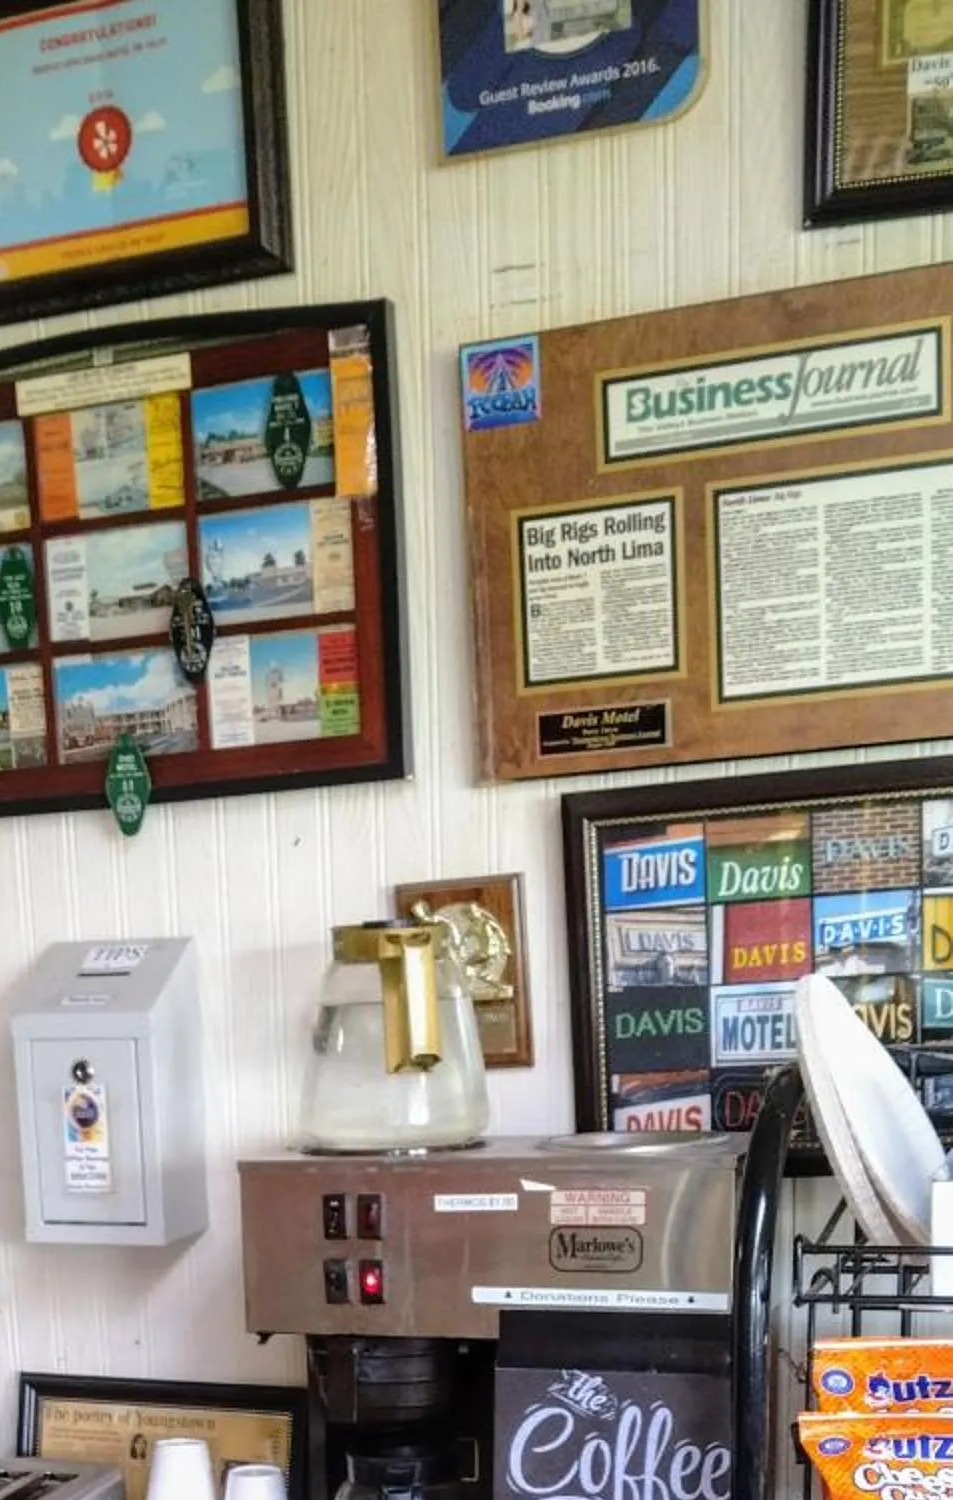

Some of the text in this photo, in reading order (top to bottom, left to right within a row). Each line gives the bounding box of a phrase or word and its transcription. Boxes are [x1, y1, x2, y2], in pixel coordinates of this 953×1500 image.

[479, 86, 519, 106] Guest
[520, 77, 568, 98] Review
[570, 66, 621, 88] Awards
[626, 338, 925, 425] Business Journal
[527, 511, 666, 549] Big Rigs Rolling
[528, 539, 665, 573] Into North Lima
[619, 847, 698, 894] DAVIS
[718, 855, 804, 897] Davis
[733, 941, 807, 969] DAVIS
[615, 1007, 704, 1040] DAVIS
[721, 1013, 798, 1053] MOTEL
[858, 1003, 914, 1042] AVIS
[563, 1191, 631, 1204] WARNING
[520, 1290, 680, 1306] Donations Please
